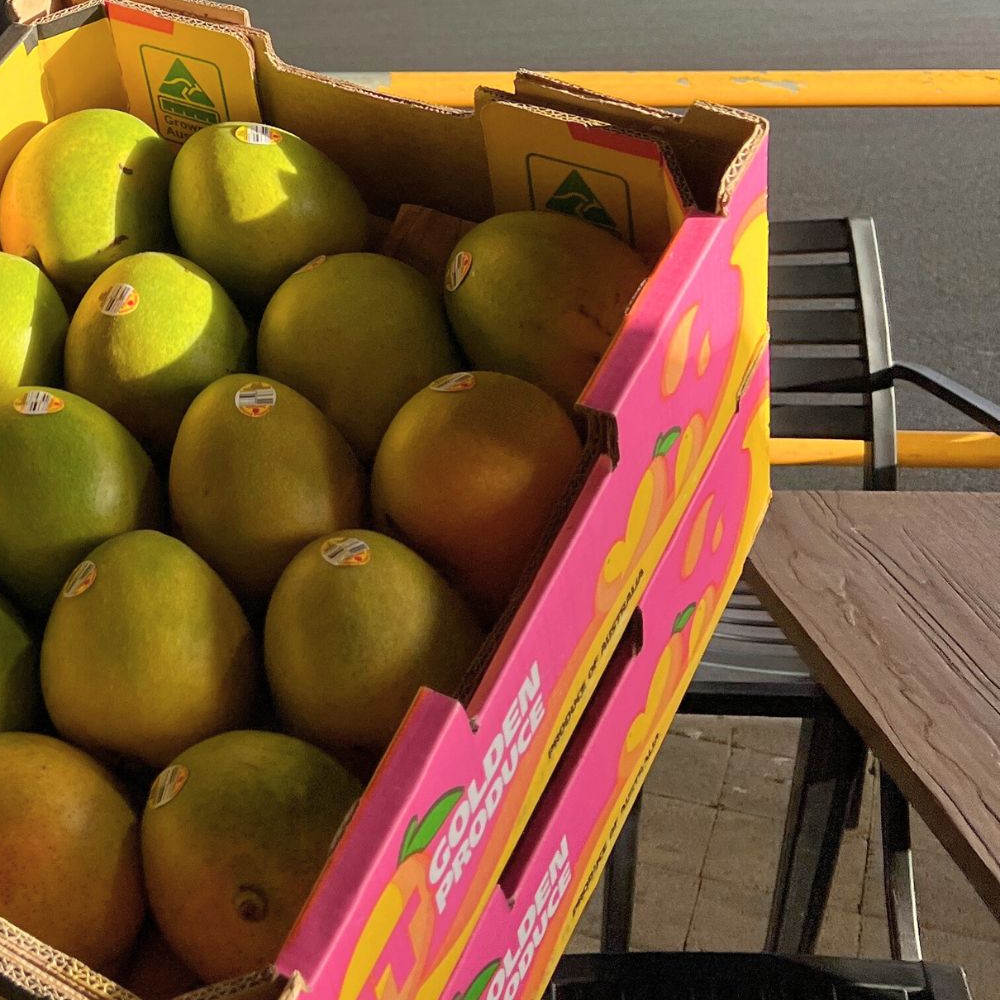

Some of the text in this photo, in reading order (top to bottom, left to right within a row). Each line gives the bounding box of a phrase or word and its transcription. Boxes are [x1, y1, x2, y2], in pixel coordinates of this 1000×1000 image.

[164, 114, 203, 132] Grow
[547, 567, 645, 760] PRODUCE OF AUSTRALIA
[428, 659, 542, 885] GOLDEN
[434, 691, 546, 916] PRODUCE
[485, 833, 569, 1000] OLDEN
[502, 860, 572, 1000] ODUCE
